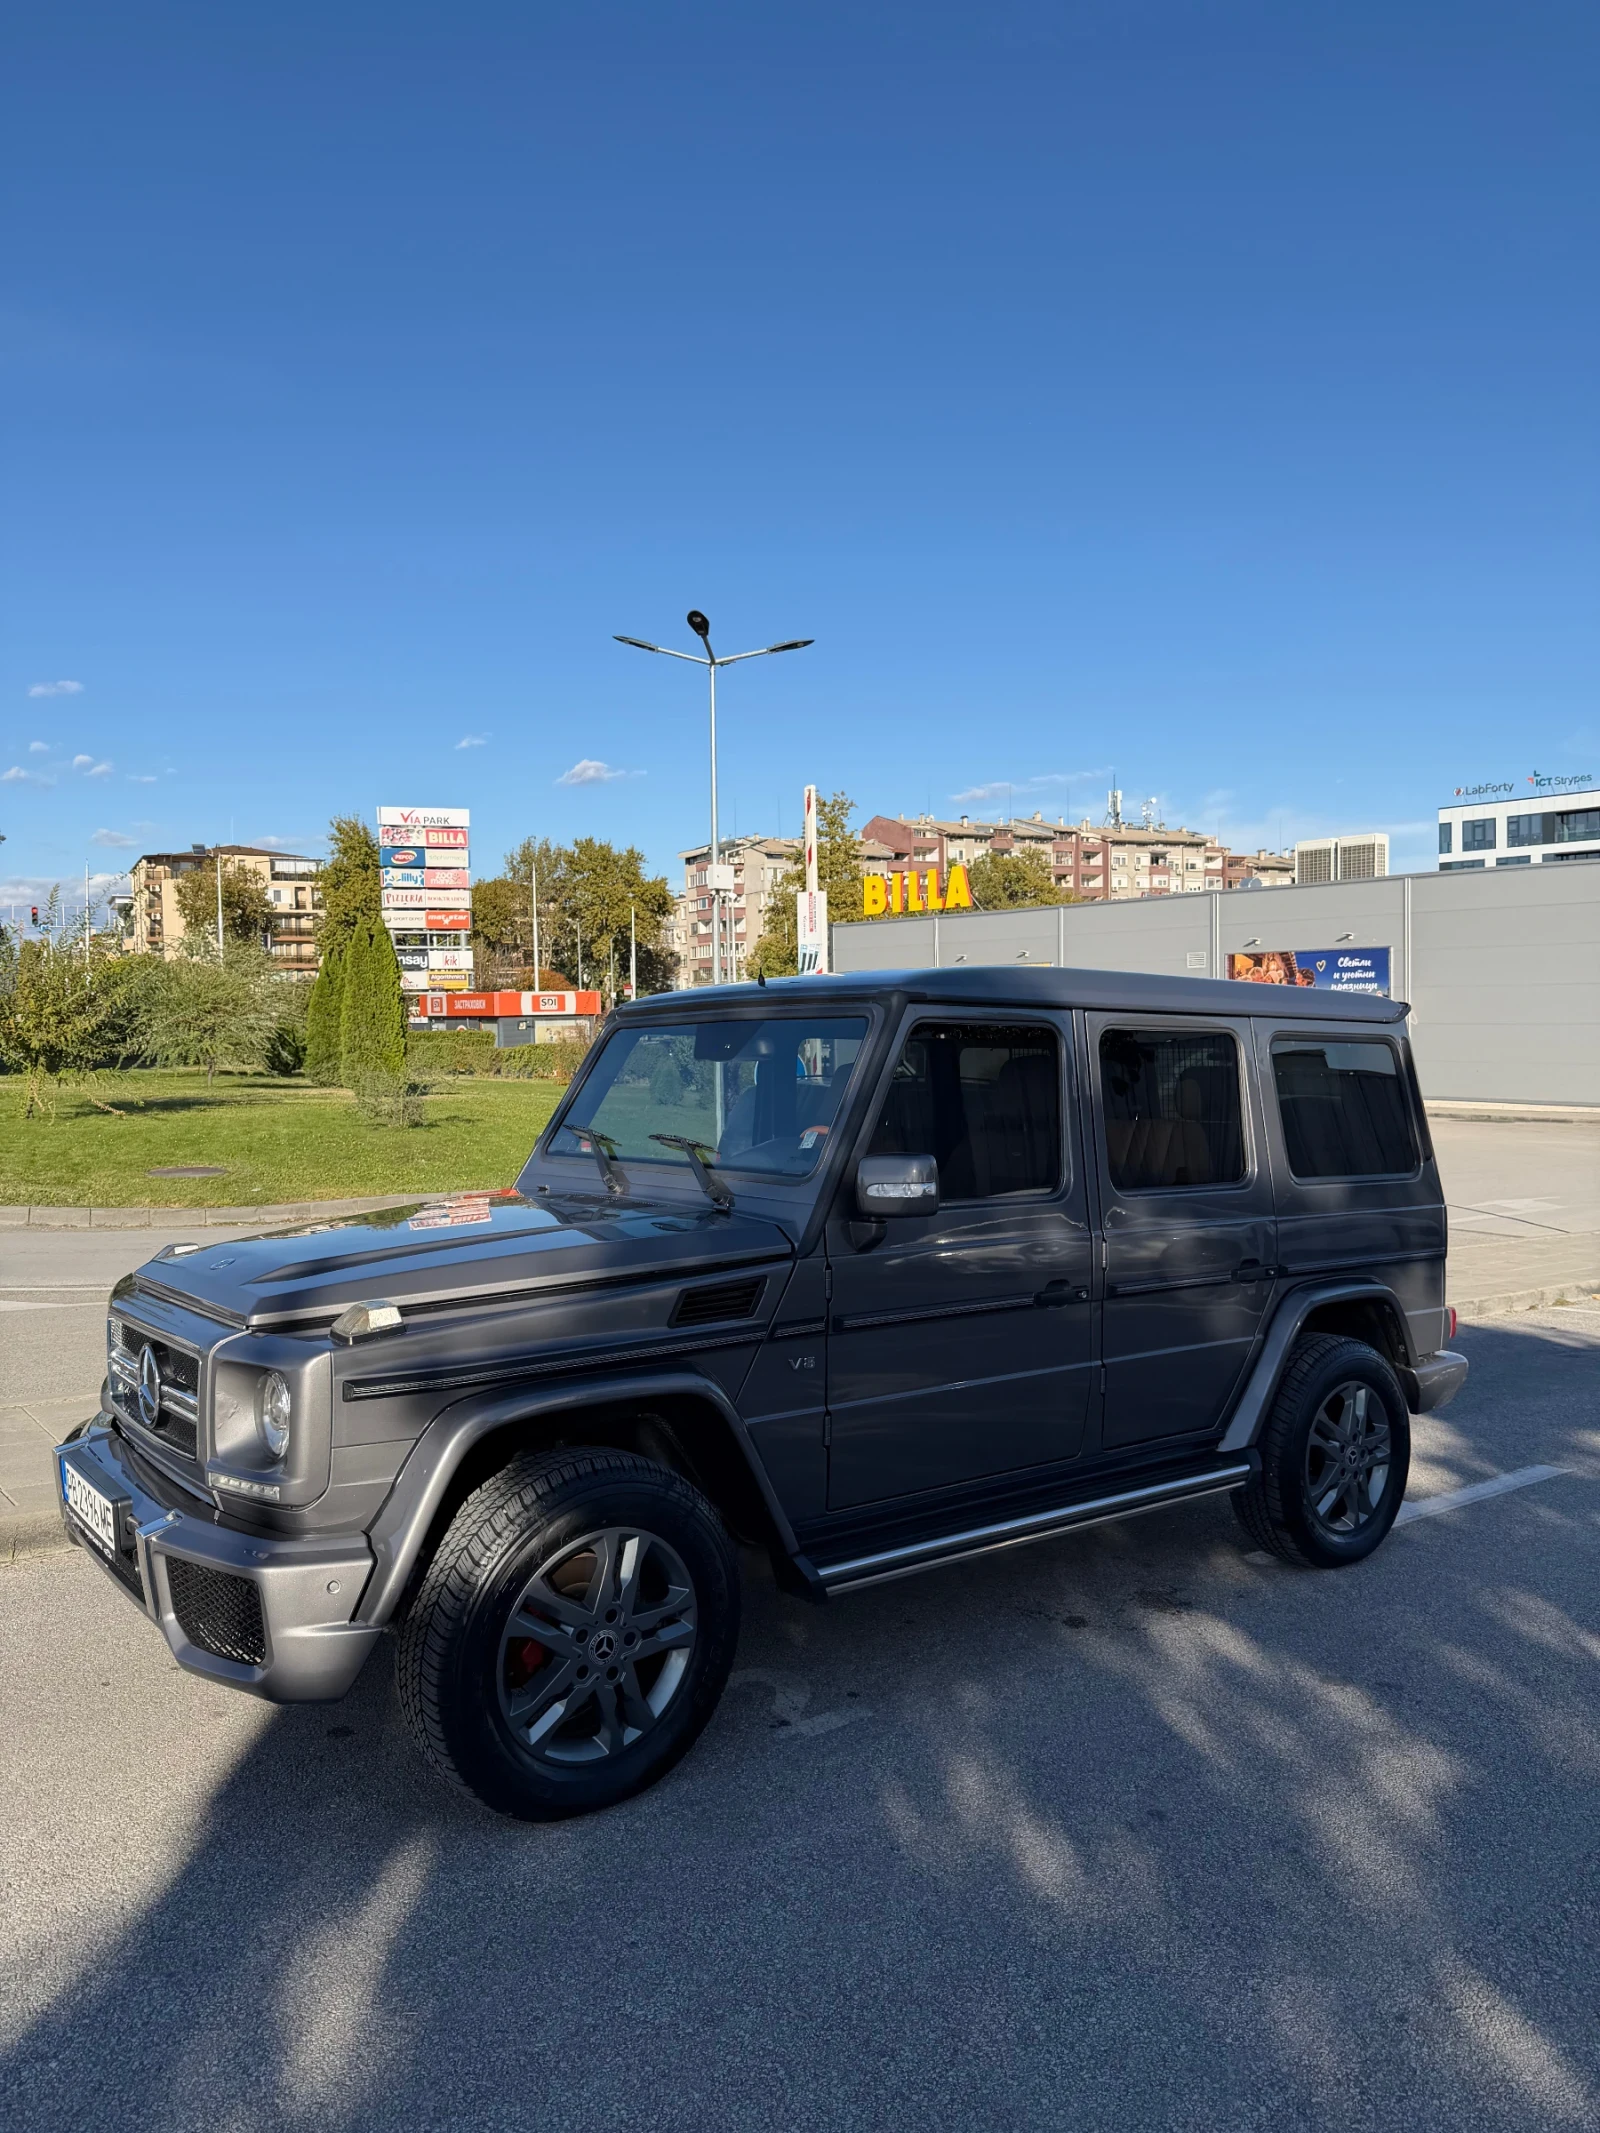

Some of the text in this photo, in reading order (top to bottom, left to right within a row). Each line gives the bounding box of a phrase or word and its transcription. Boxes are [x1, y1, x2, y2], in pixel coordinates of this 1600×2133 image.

[1535, 773, 1592, 787] ICT Strypes
[1465, 782, 1514, 795] LabForty
[423, 816, 450, 825] PARK
[428, 831, 466, 845] BILLA
[401, 872, 418, 884] lilly
[863, 865, 973, 915] BILLA
[444, 954, 458, 966] kik
[1337, 957, 1372, 967] Светли
[1342, 969, 1375, 982] уютни
[541, 998, 556, 1007] SDI
